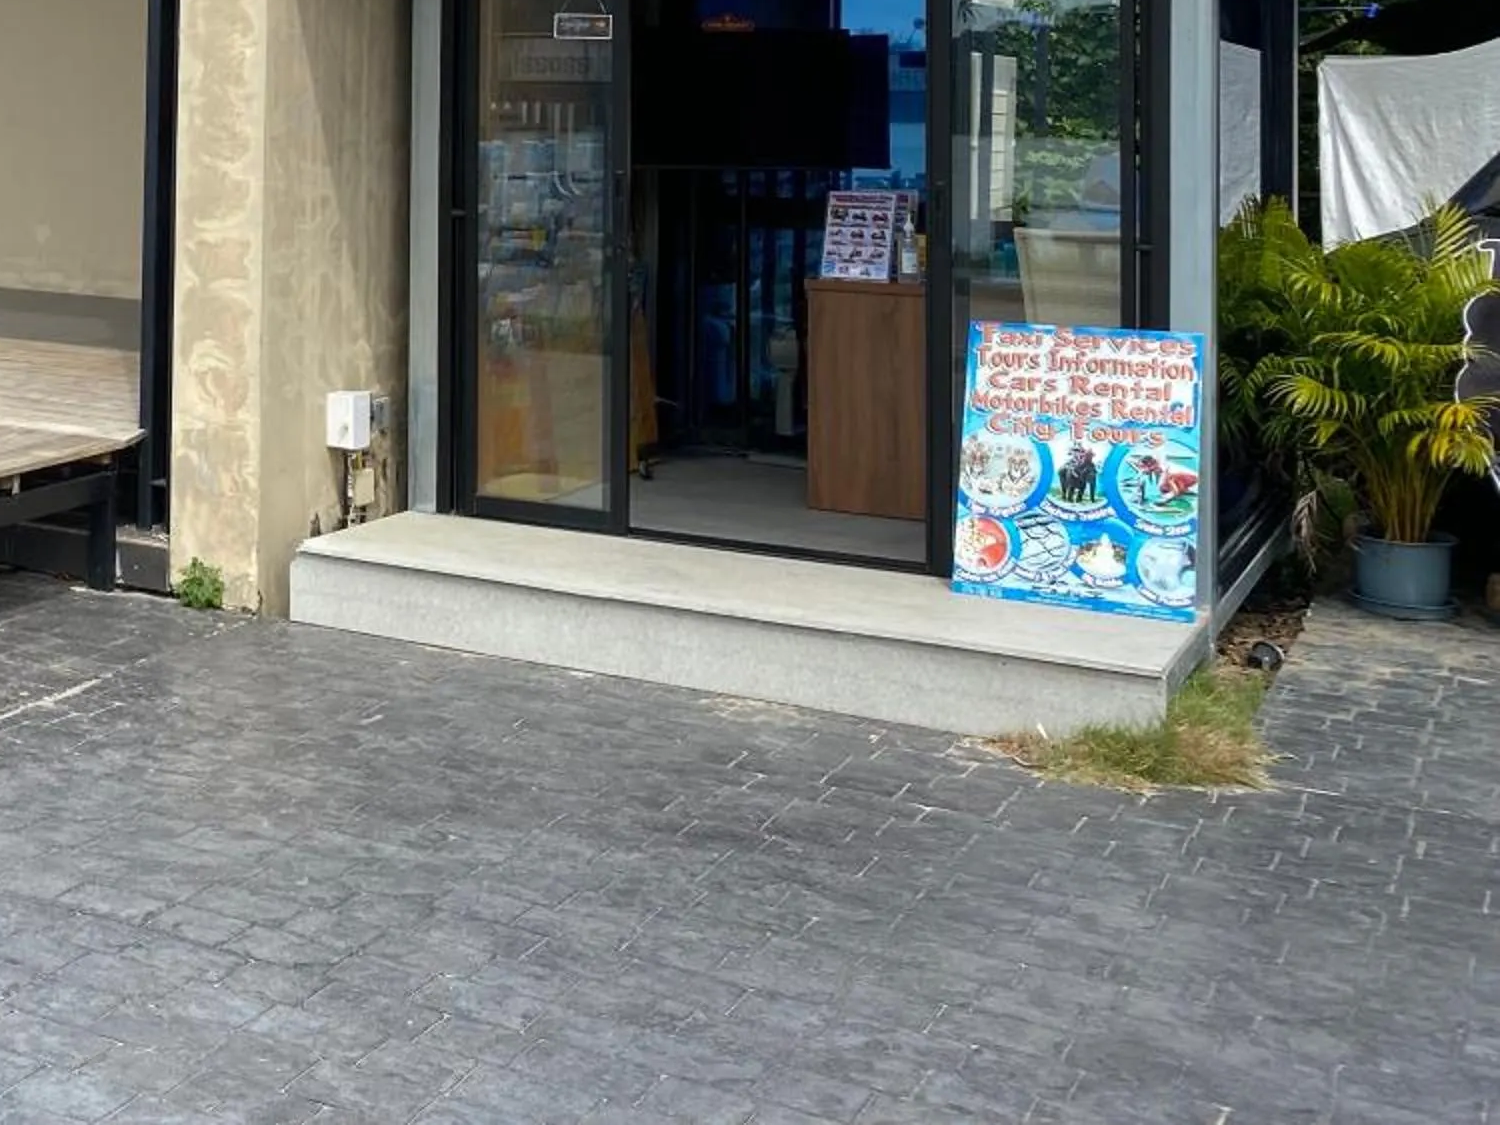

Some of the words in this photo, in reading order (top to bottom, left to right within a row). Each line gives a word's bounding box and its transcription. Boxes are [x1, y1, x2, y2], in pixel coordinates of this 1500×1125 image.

[978, 323, 1043, 348] Taxi
[1053, 328, 1195, 357] Services
[977, 344, 1042, 370] Tours
[1048, 348, 1195, 382] Information
[988, 371, 1058, 393] Cars
[1070, 375, 1173, 402] Rental
[971, 390, 1103, 418] Motorbikes
[1111, 398, 1193, 426] Rental
[987, 413, 1056, 442] City
[1071, 416, 1165, 448] Tours
